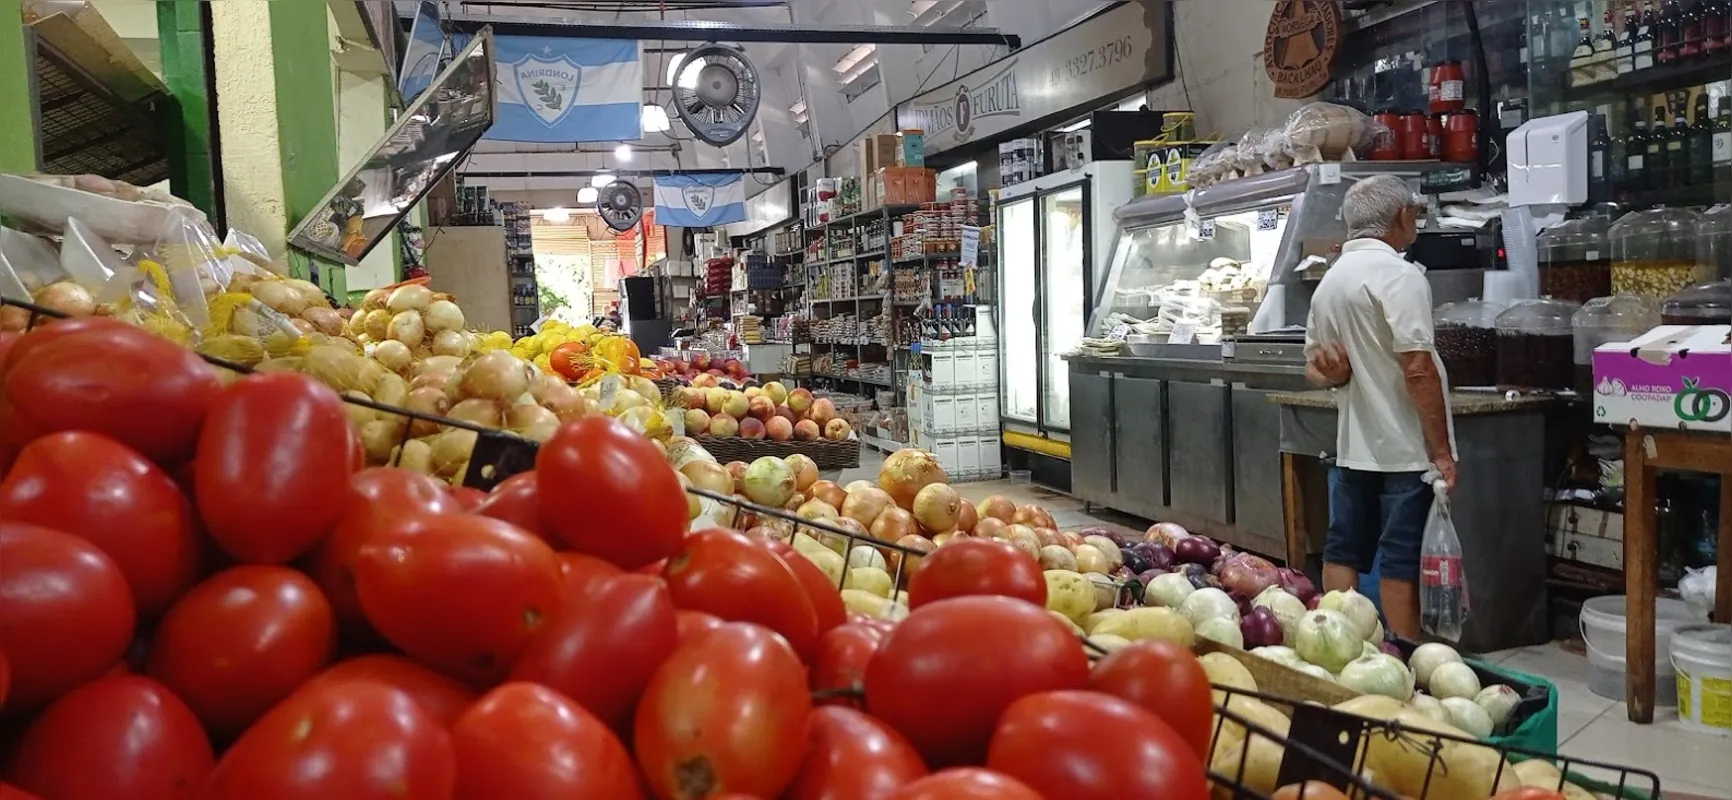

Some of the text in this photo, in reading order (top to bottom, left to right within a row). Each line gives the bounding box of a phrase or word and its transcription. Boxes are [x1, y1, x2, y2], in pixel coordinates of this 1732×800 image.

[1065, 35, 1132, 81] 3327.3796
[973, 68, 1020, 116] FURUTA
[1631, 393, 1672, 402] COOPADAP
